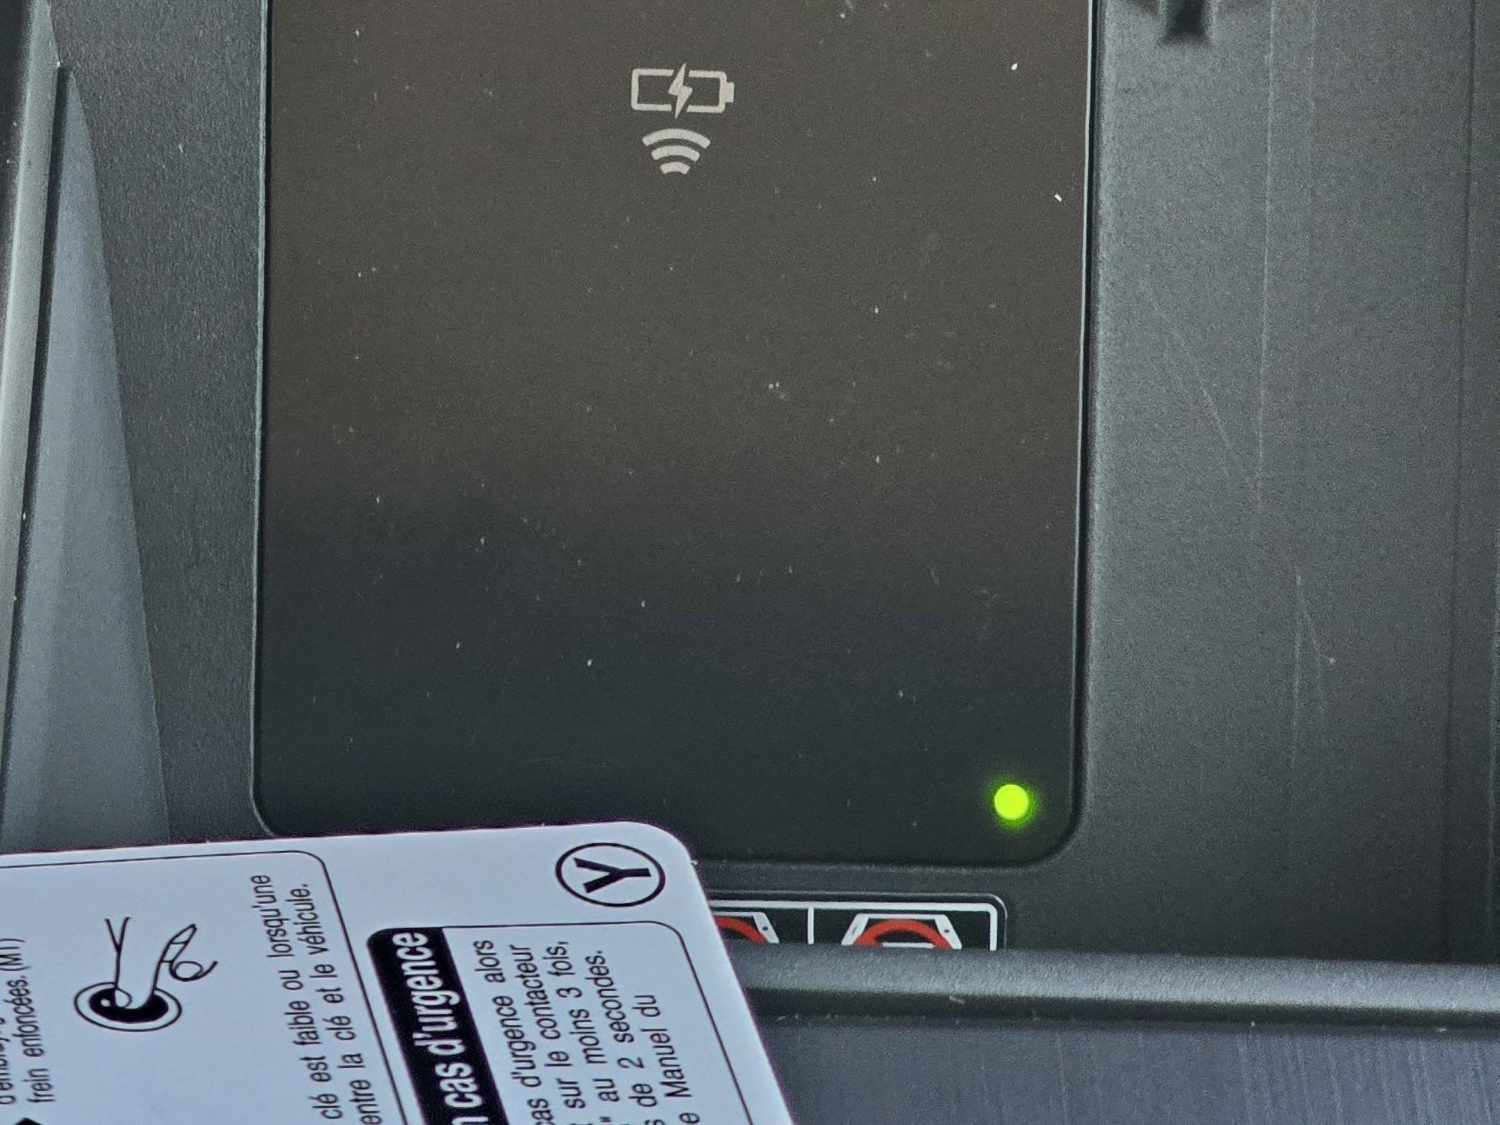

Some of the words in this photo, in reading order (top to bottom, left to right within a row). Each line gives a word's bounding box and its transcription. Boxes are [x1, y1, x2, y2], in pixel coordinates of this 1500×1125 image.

[573, 857, 652, 894] Y
[251, 875, 294, 958] lorsqu'une
[285, 883, 329, 955] véhicule.
[309, 964, 338, 978] le
[473, 940, 506, 984] alors
[542, 941, 575, 977] fois,
[278, 970, 303, 990] ou
[315, 987, 344, 1003] et
[392, 932, 465, 1056] d'urgence
[509, 944, 561, 1040] contacteur
[557, 987, 583, 999] 3
[585, 950, 634, 1044] secondes.
[284, 1000, 323, 1046] faible
[632, 995, 661, 1018] du
[322, 1015, 355, 1041] clé
[491, 995, 541, 1088] d'urgence
[569, 1009, 607, 1065] moins
[300, 1056, 331, 1083] est
[337, 1053, 366, 1068] la
[544, 1050, 572, 1067] le
[617, 1057, 645, 1069] 2
[640, 1028, 692, 1100] Manuel
[20, 1068, 55, 1103] frein
[349, 1079, 382, 1125] entre
[435, 1062, 483, 1109] cas
[556, 1078, 586, 1109] sur
[593, 1078, 620, 1102] au
[628, 1083, 657, 1108] de
[309, 1092, 343, 1119] clé
